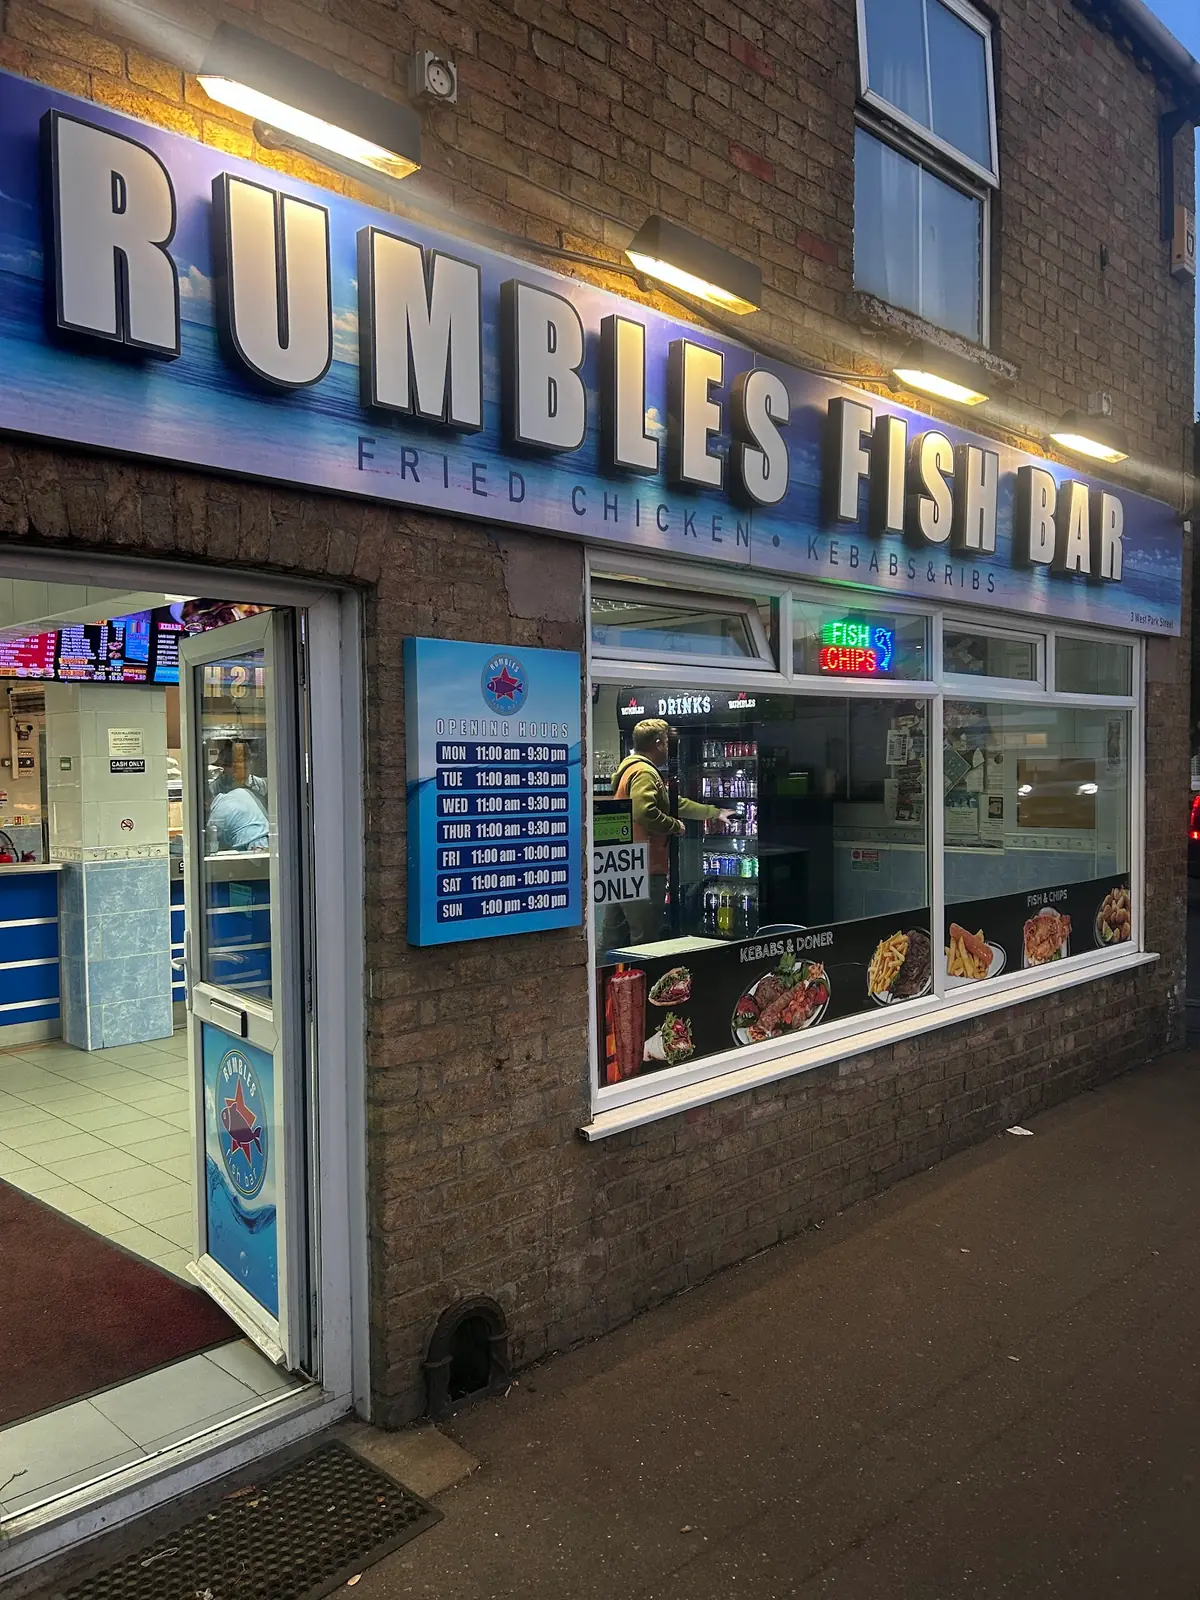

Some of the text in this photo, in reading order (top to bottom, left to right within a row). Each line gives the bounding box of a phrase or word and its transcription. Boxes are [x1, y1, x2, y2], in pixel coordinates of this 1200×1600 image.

[40, 107, 1124, 582] RUMBLES FISH BAR
[357, 436, 526, 503] FRIED
[571, 485, 751, 548] CHICKEN
[1130, 611, 1174, 629] 3 West Park Street
[832, 622, 870, 647] FISH
[490, 658, 520, 672] RUMBLES
[827, 647, 877, 671] CHIPS
[658, 695, 711, 716] DRINKS
[436, 718, 569, 738] OPENING HOURS
[442, 746, 466, 760] MON
[475, 745, 501, 760] 11:00
[504, 747, 520, 760] am
[527, 747, 550, 761] 9:30
[551, 748, 566, 762] pm
[443, 772, 463, 786] TUE
[476, 771, 502, 786] 11:00
[504, 774, 520, 785] am
[528, 771, 550, 785] 9:30
[551, 774, 566, 786] pm
[443, 798, 468, 813] WED
[476, 797, 502, 812] 11:00
[504, 799, 521, 811] am
[528, 796, 550, 811] 9:30
[551, 797, 566, 811] pm
[443, 824, 471, 839] THUR
[476, 822, 502, 837] 11:00
[504, 825, 521, 836] am
[528, 821, 550, 835] 9:30
[551, 822, 566, 836] pm
[443, 851, 461, 866] FRI
[471, 848, 498, 864] 11:00
[500, 850, 516, 862] am
[523, 845, 549, 860] 10:00
[551, 846, 566, 860] pm
[593, 848, 644, 875] CASH
[443, 877, 462, 893] SAT
[471, 874, 498, 890] 11:00
[500, 876, 516, 888] am
[523, 870, 549, 885] 10:00
[551, 870, 566, 884] pm
[593, 876, 644, 903] ONLY
[443, 903, 463, 918] SUN
[481, 899, 503, 915] 1:00
[505, 900, 520, 914] pm
[528, 894, 550, 909] 9:30
[551, 894, 566, 909] pm
[1027, 889, 1068, 907] FISH & CHIPS
[740, 931, 833, 962] KEBABS & DONER
[223, 1057, 256, 1097] RUMBLES
